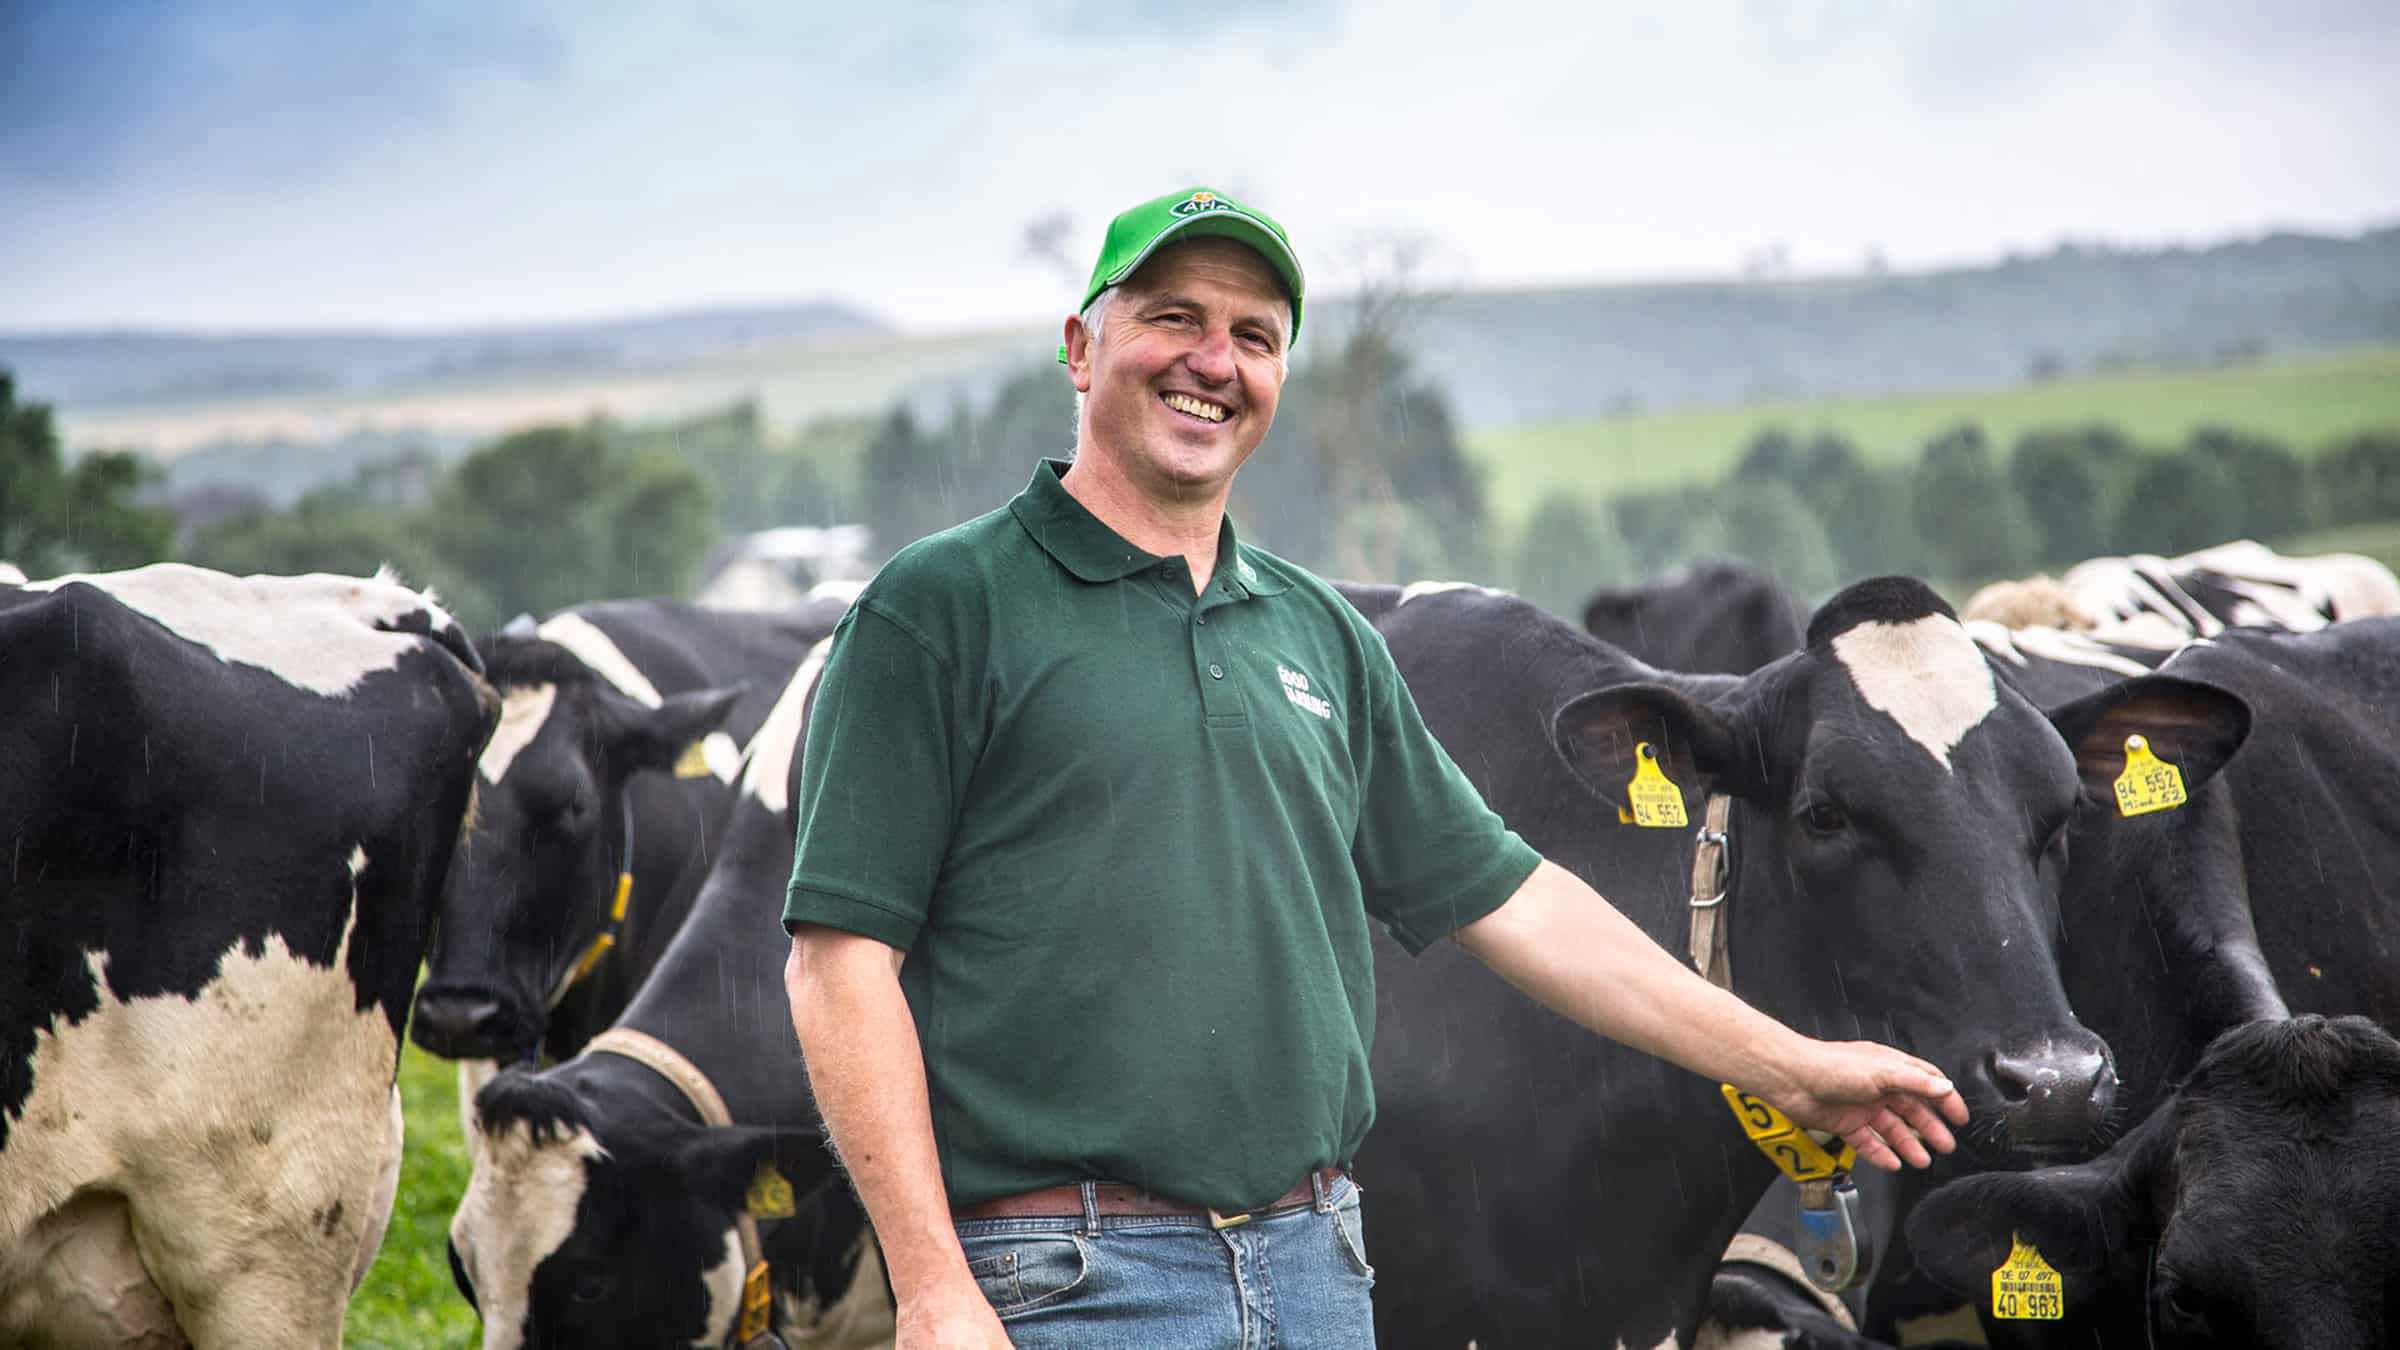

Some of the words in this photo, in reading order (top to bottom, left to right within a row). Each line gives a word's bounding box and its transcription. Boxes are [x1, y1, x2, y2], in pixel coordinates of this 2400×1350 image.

[2145, 769, 2177, 793] 552
[1657, 803, 1684, 825] 552
[1737, 1092, 1773, 1129] 5
[1776, 1144, 1815, 1175] 2
[1997, 1293, 2017, 1317] 40
[2027, 1294, 2059, 1317] 963
